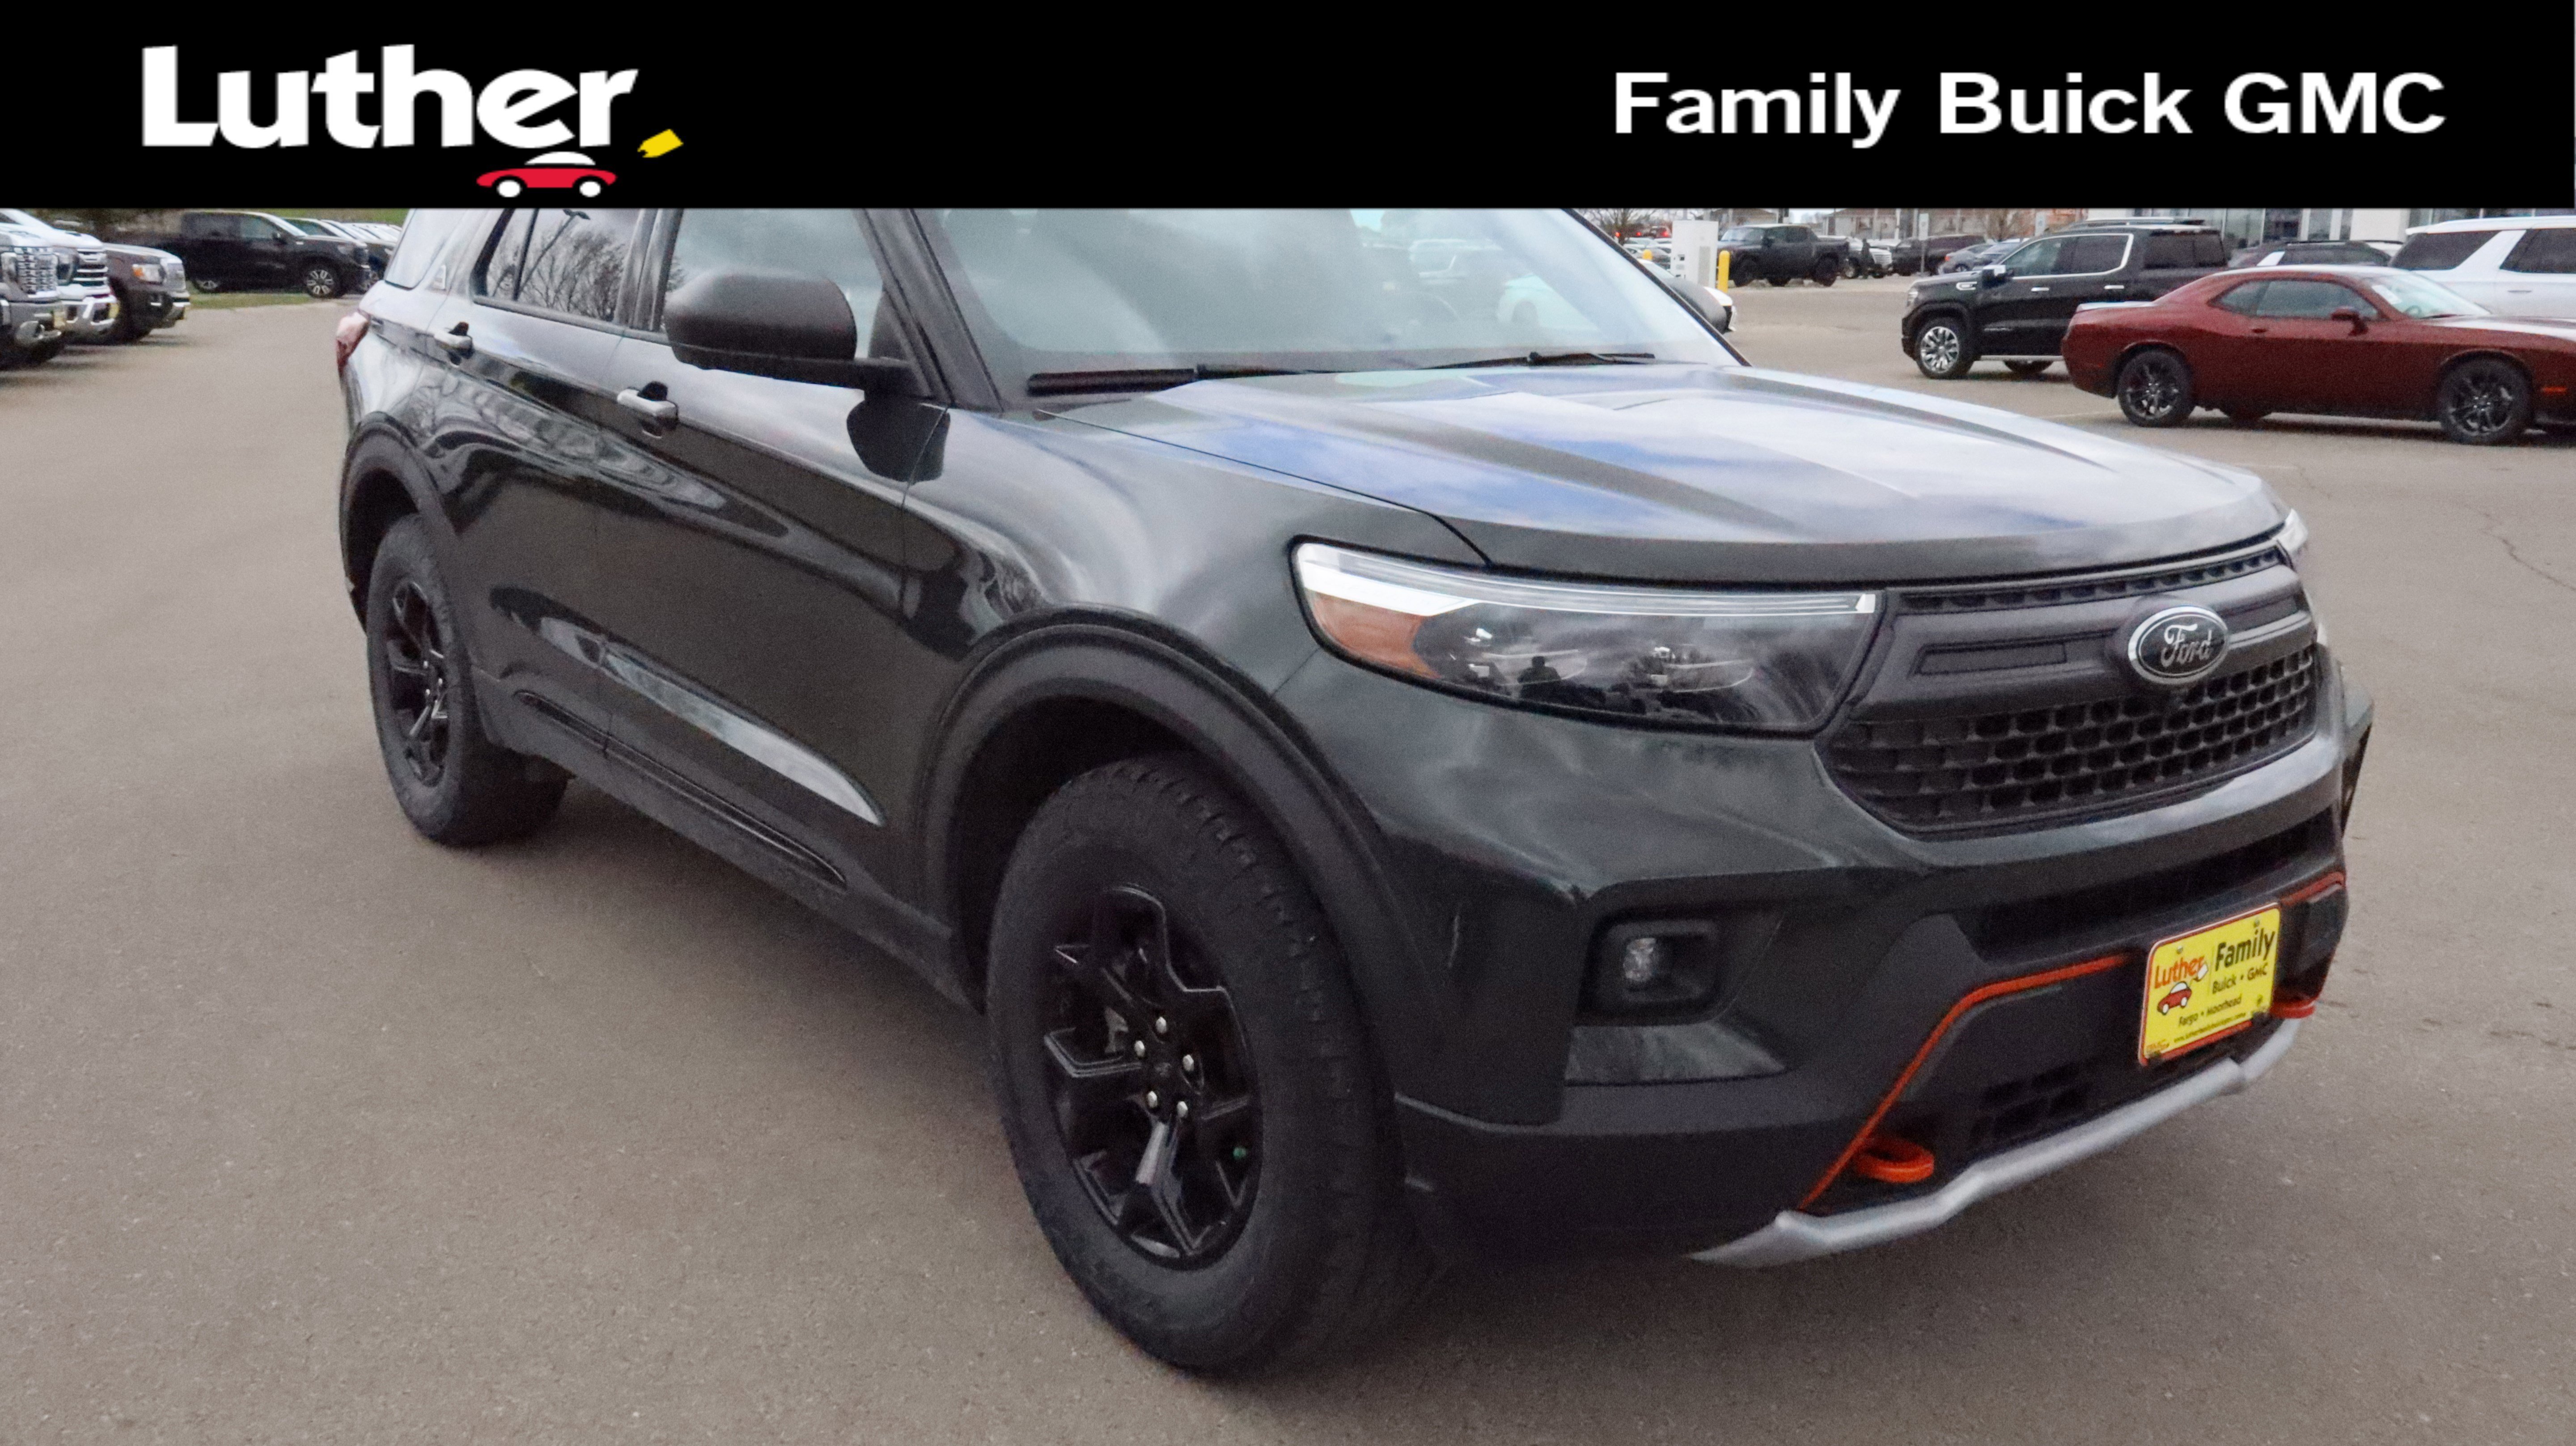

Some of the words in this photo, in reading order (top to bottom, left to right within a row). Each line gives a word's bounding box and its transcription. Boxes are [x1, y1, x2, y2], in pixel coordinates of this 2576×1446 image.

[2161, 623, 2212, 668] Ford
[2216, 928, 2275, 971] Family
[2154, 955, 2205, 989] Luther
[2212, 974, 2236, 994] Buick
[2247, 963, 2268, 980] GMC
